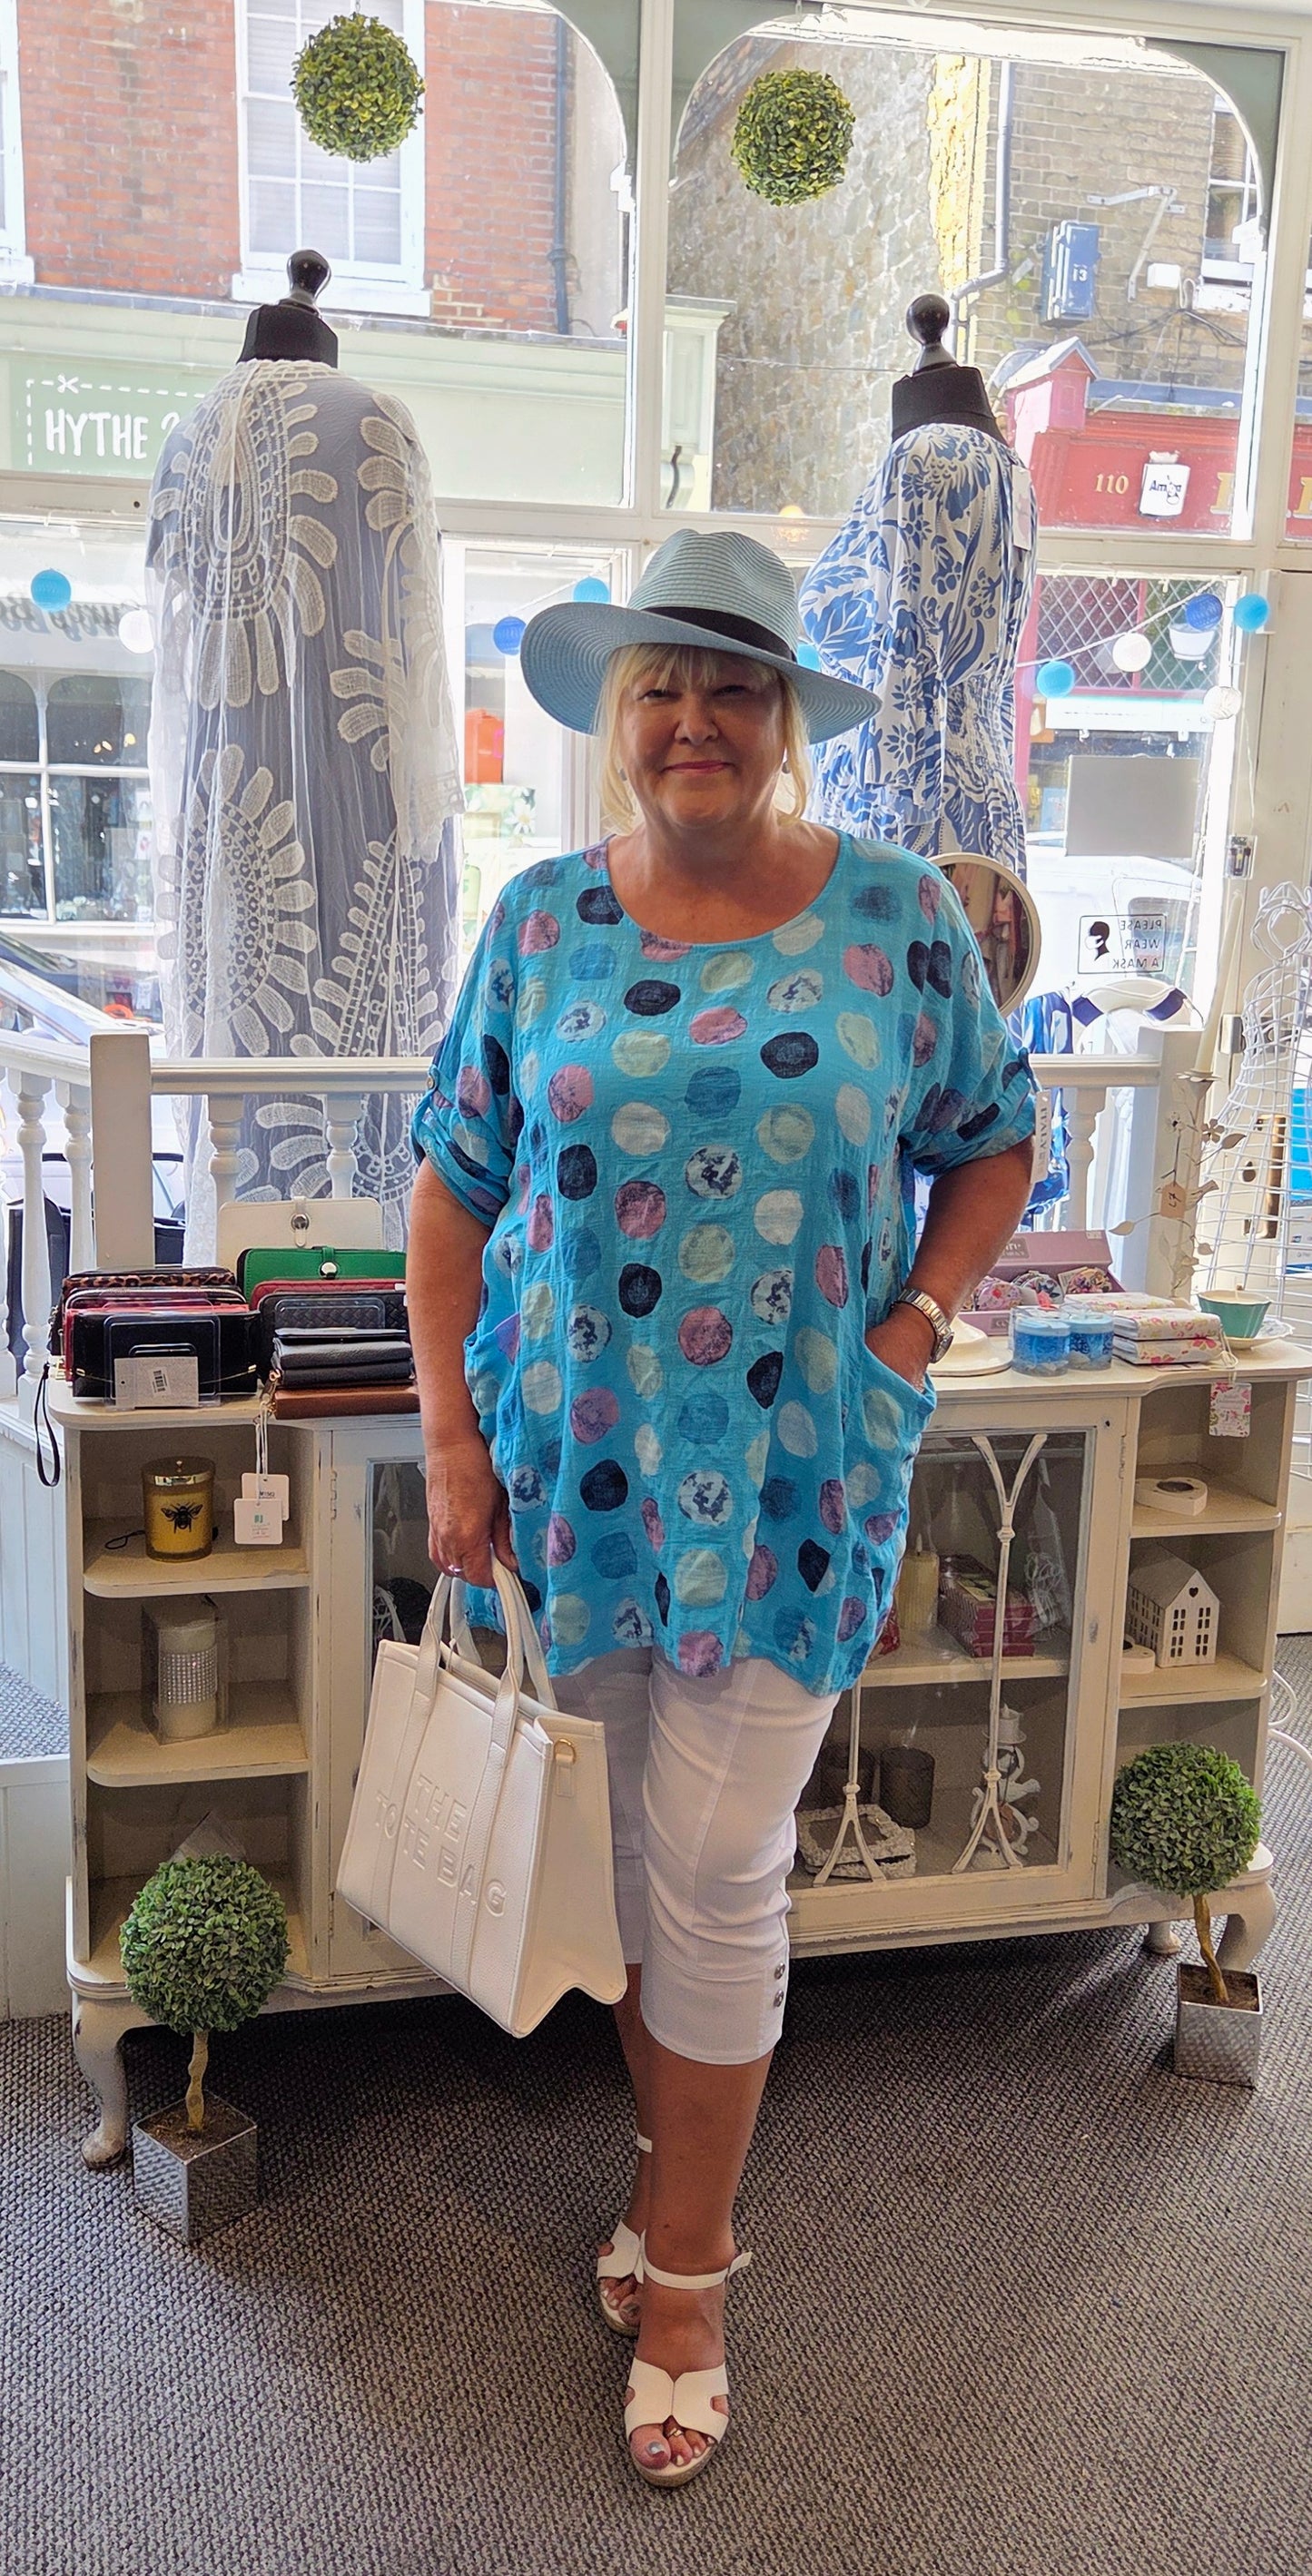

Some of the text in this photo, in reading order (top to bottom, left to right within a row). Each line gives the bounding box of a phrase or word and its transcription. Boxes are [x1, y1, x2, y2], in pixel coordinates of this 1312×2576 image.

[44, 408, 149, 460] HYTHE
[1094, 473, 1130, 495] 110
[416, 1773, 468, 1844] THE
[375, 1789, 508, 1918] TOTE BAG
